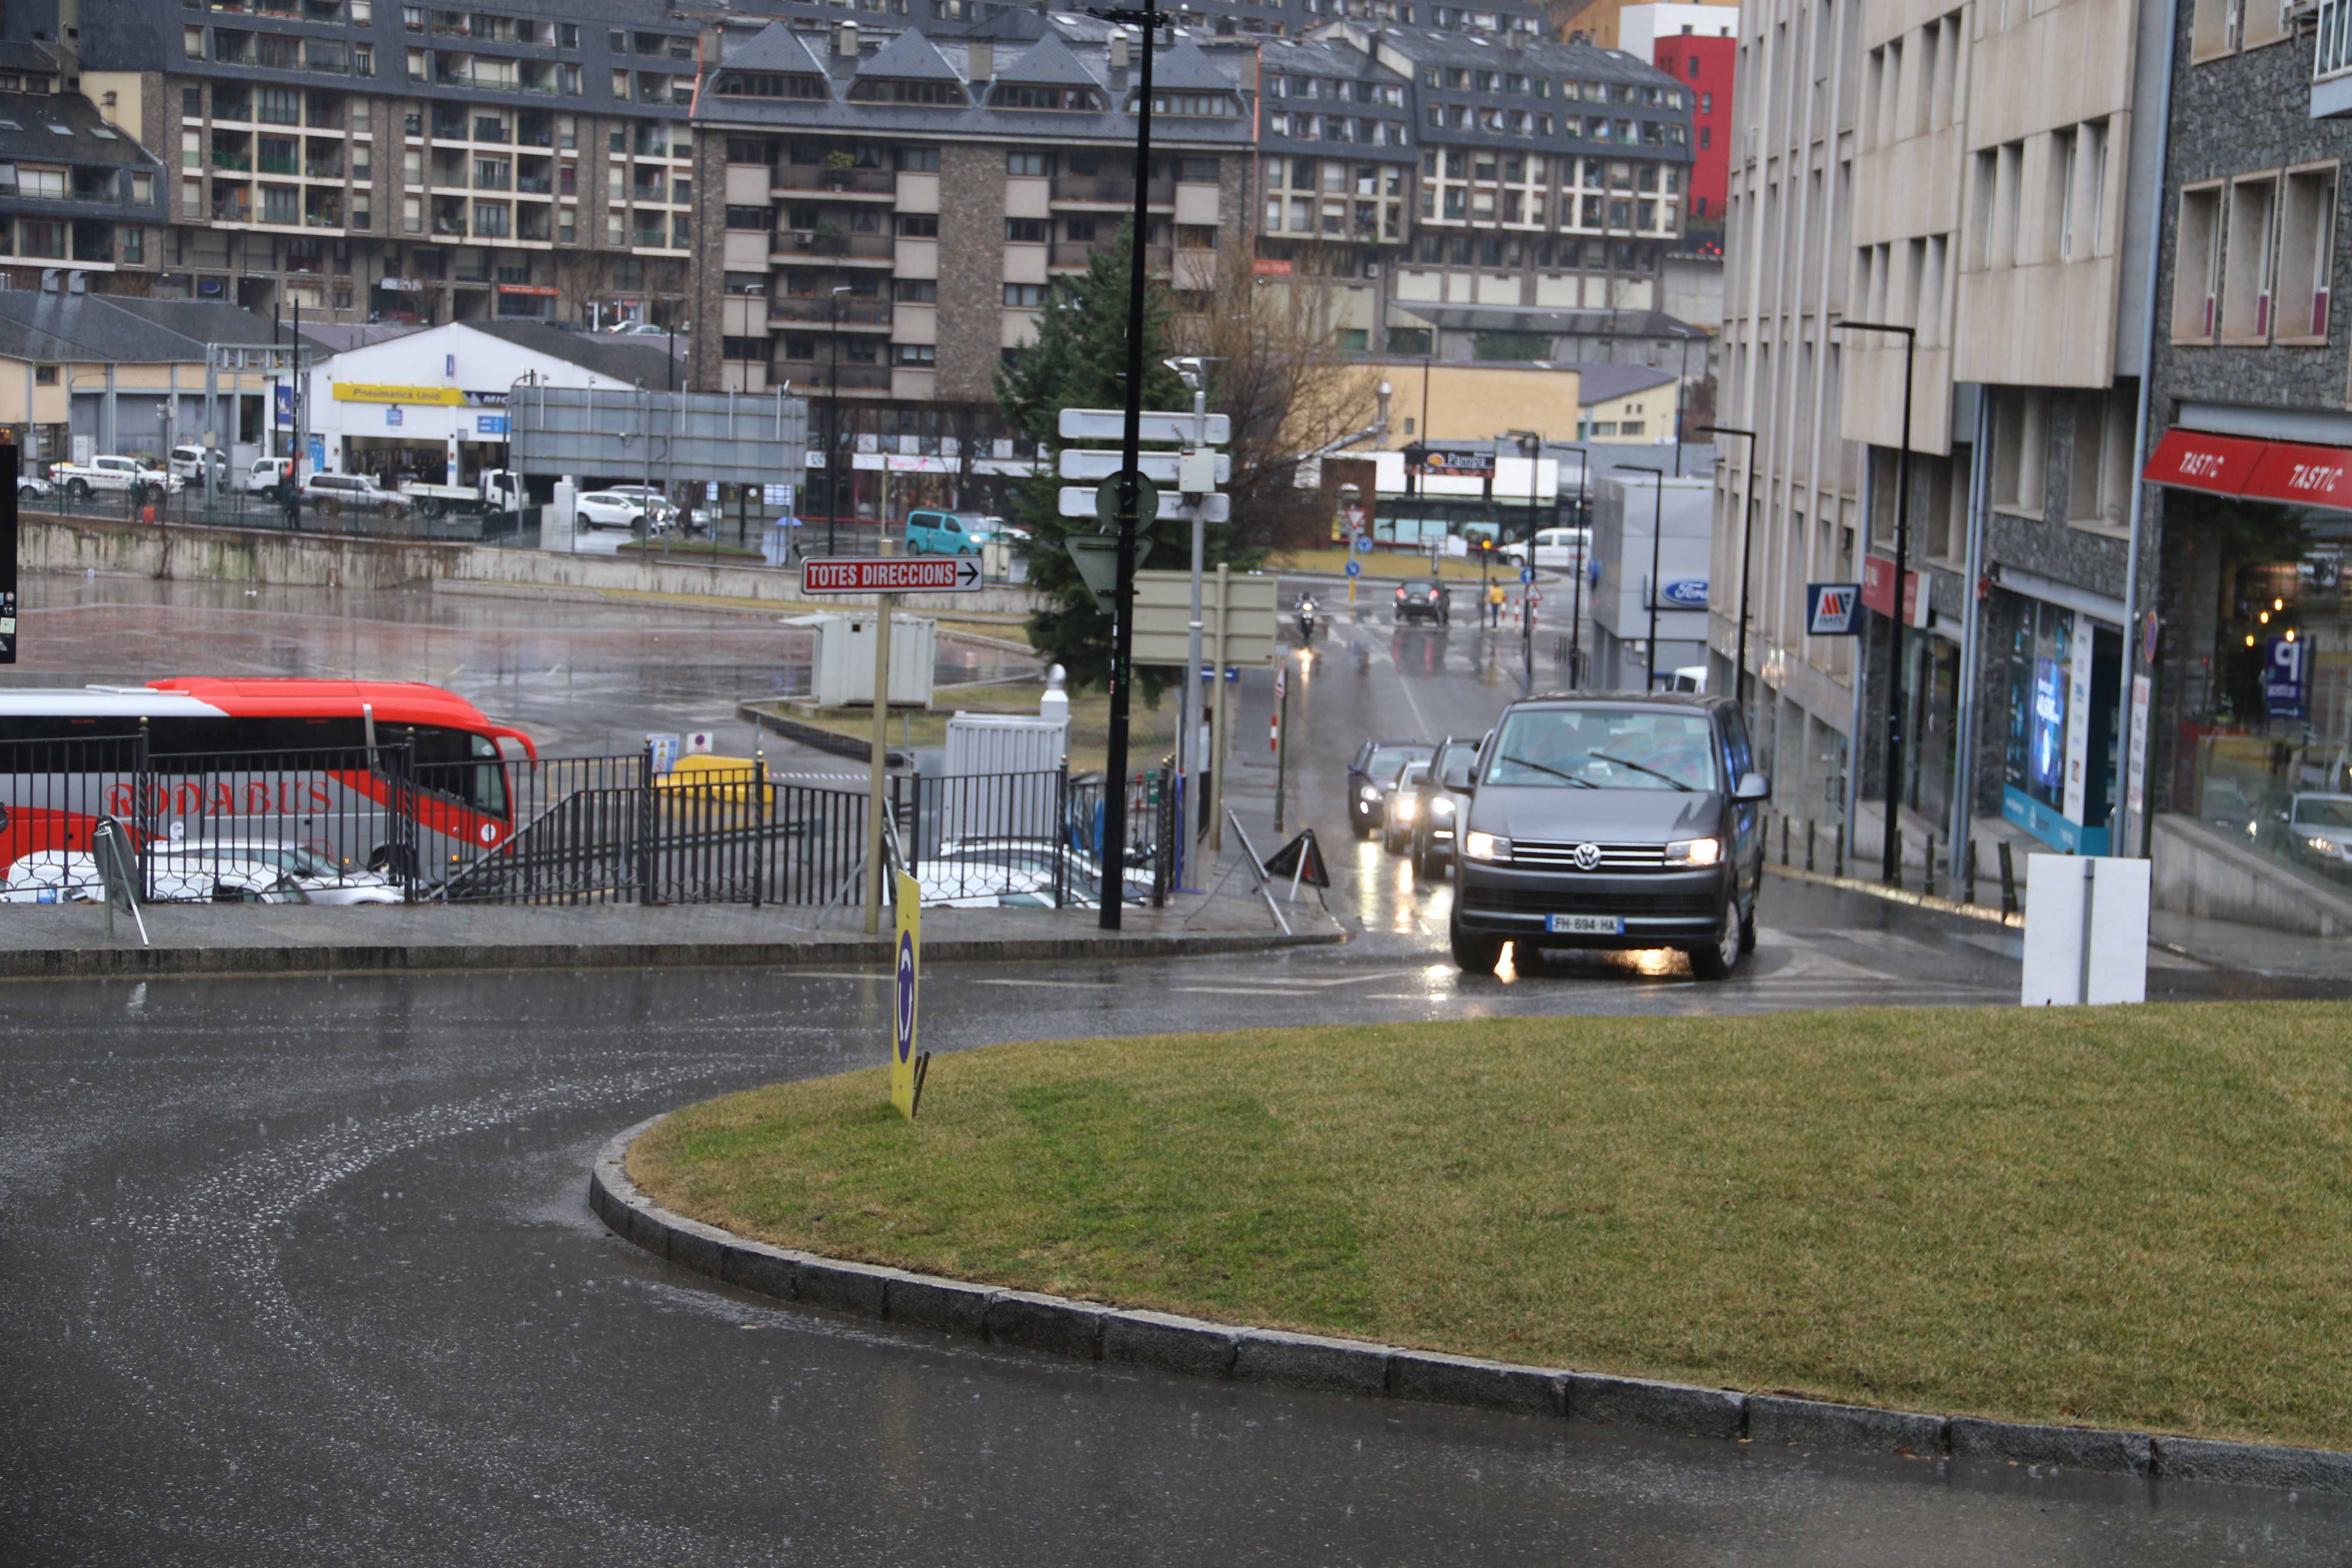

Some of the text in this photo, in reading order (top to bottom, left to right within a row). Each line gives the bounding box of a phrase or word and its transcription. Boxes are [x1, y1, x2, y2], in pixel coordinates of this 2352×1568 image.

[1448, 452, 1486, 469] Pampa
[2178, 451, 2225, 478] TASTIC
[2288, 464, 2343, 493] TASTIC
[809, 564, 954, 586] TOTES DIRECCIONS
[104, 780, 332, 815] RODABUS
